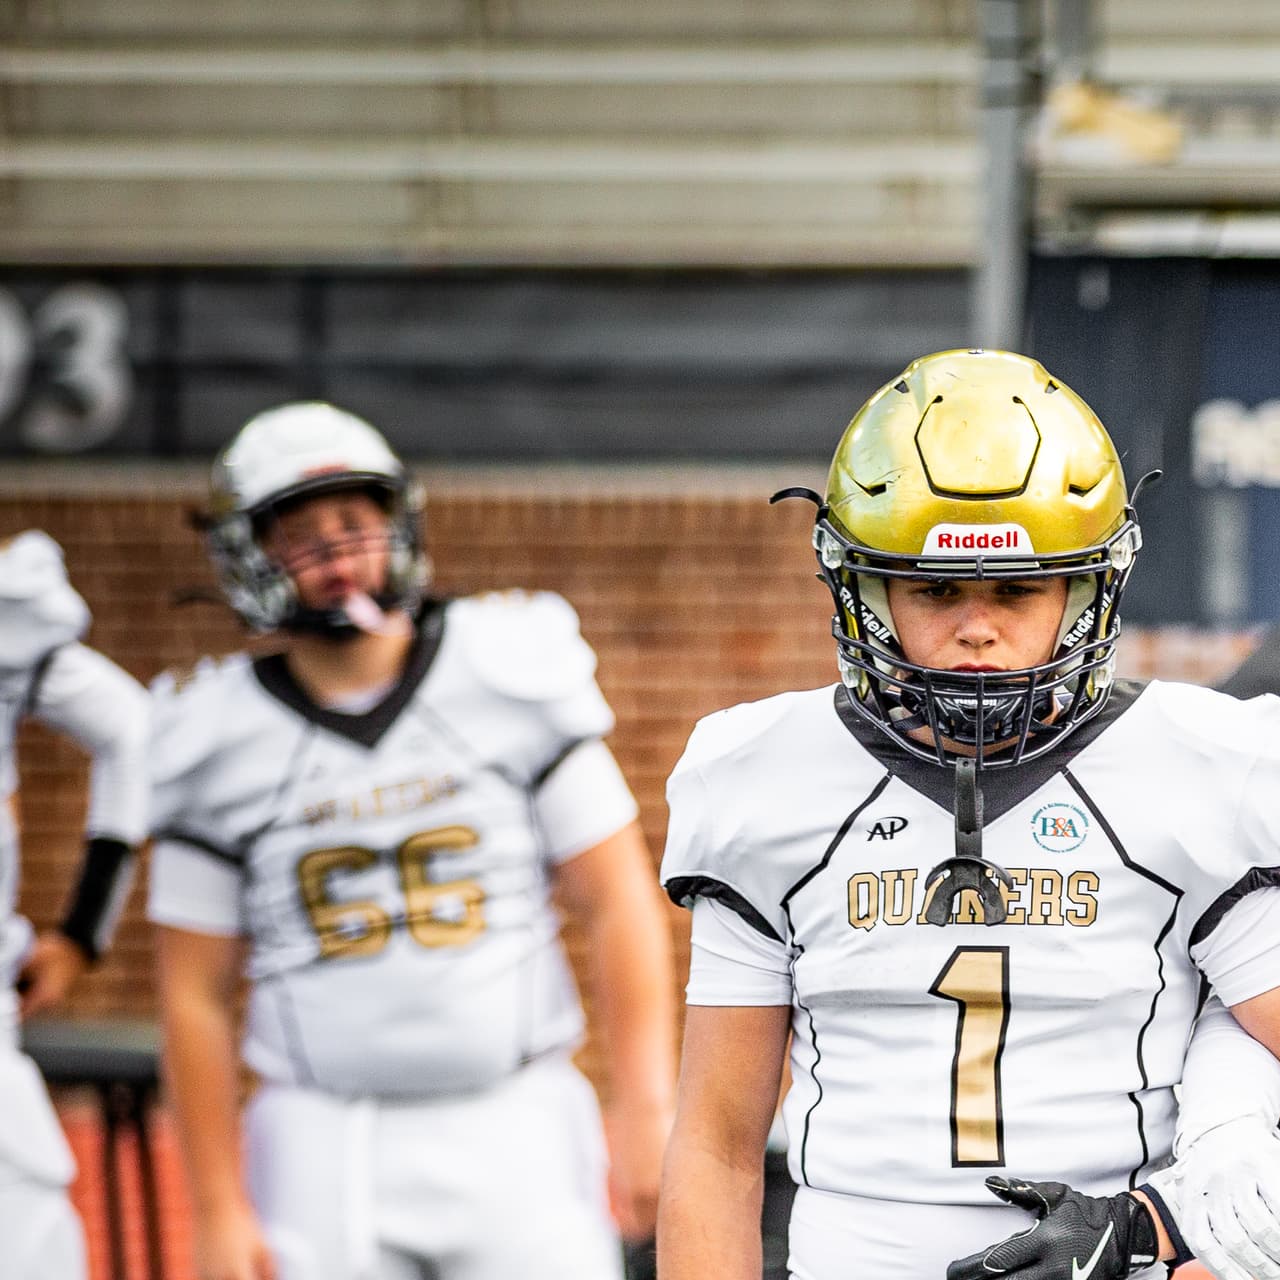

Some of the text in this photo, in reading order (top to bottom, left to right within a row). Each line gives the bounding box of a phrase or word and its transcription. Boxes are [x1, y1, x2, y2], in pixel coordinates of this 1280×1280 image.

[938, 531, 1018, 549] Riddell
[867, 816, 908, 842] AP
[928, 945, 1011, 1168] 1
